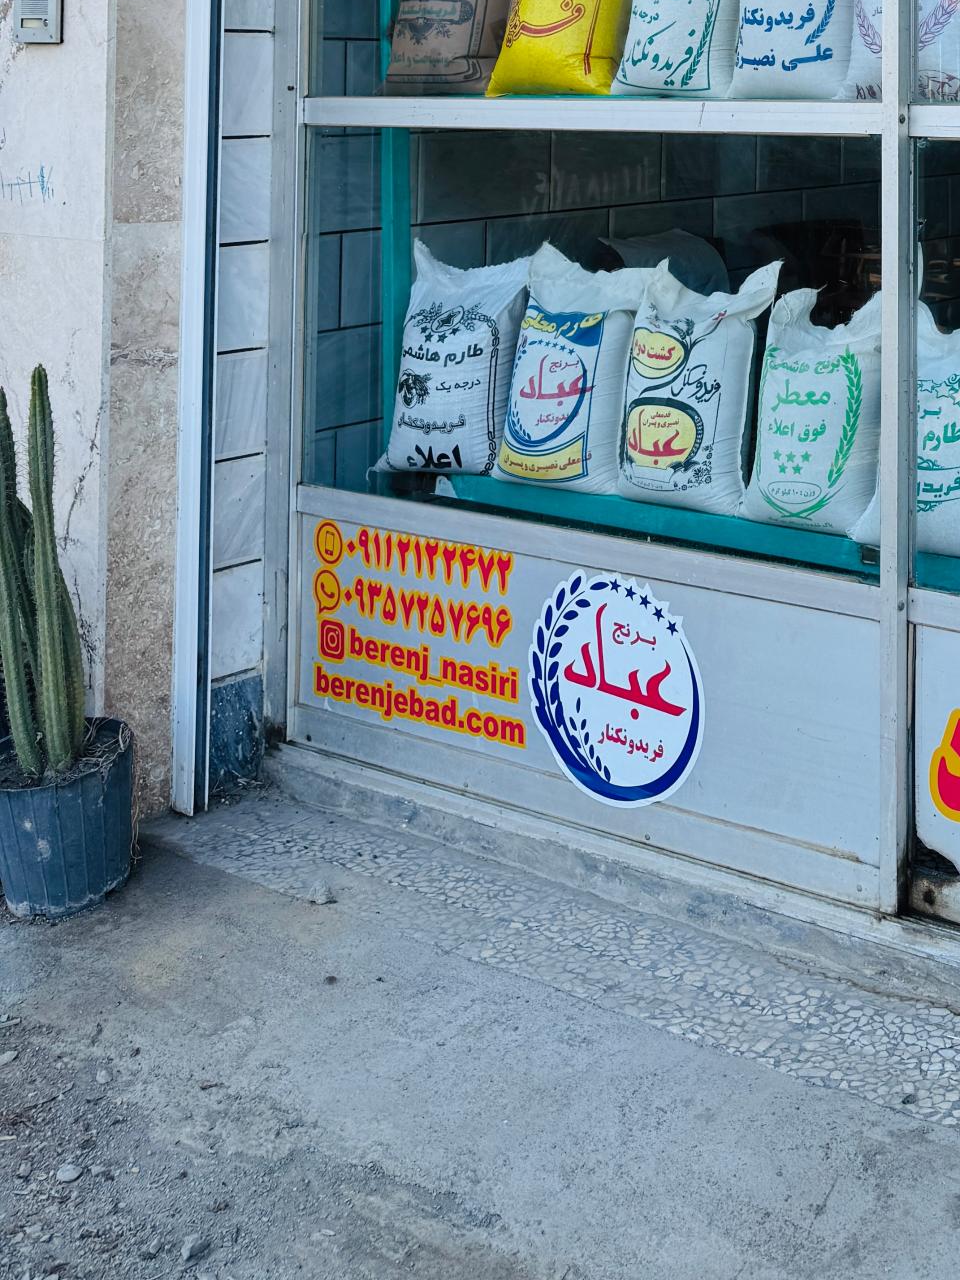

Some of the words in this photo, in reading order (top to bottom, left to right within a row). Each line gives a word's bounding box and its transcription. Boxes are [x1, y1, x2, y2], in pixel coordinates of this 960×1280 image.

[781, 43, 834, 72] علی
[443, 343, 484, 368] طارم
[549, 358, 580, 373] برنج
[646, 345, 676, 362] کشت
[813, 355, 841, 375] برنج
[435, 381, 452, 394] یک
[454, 378, 481, 391] درجه
[770, 378, 832, 412] معطر
[627, 408, 690, 467] عباد
[797, 418, 828, 443] فوق
[346, 527, 512, 595] ۰۹۱۱۲۱۲۲۴۷۲
[343, 577, 512, 646] ۰۹۳۵۷۲۵۷۶۹۶
[612, 620, 657, 652] برنج
[349, 627, 519, 701] berenj_nasiri
[563, 602, 688, 721] عباد
[315, 665, 526, 746] berenjebad.com
[597, 723, 665, 761] فریدونکنار
